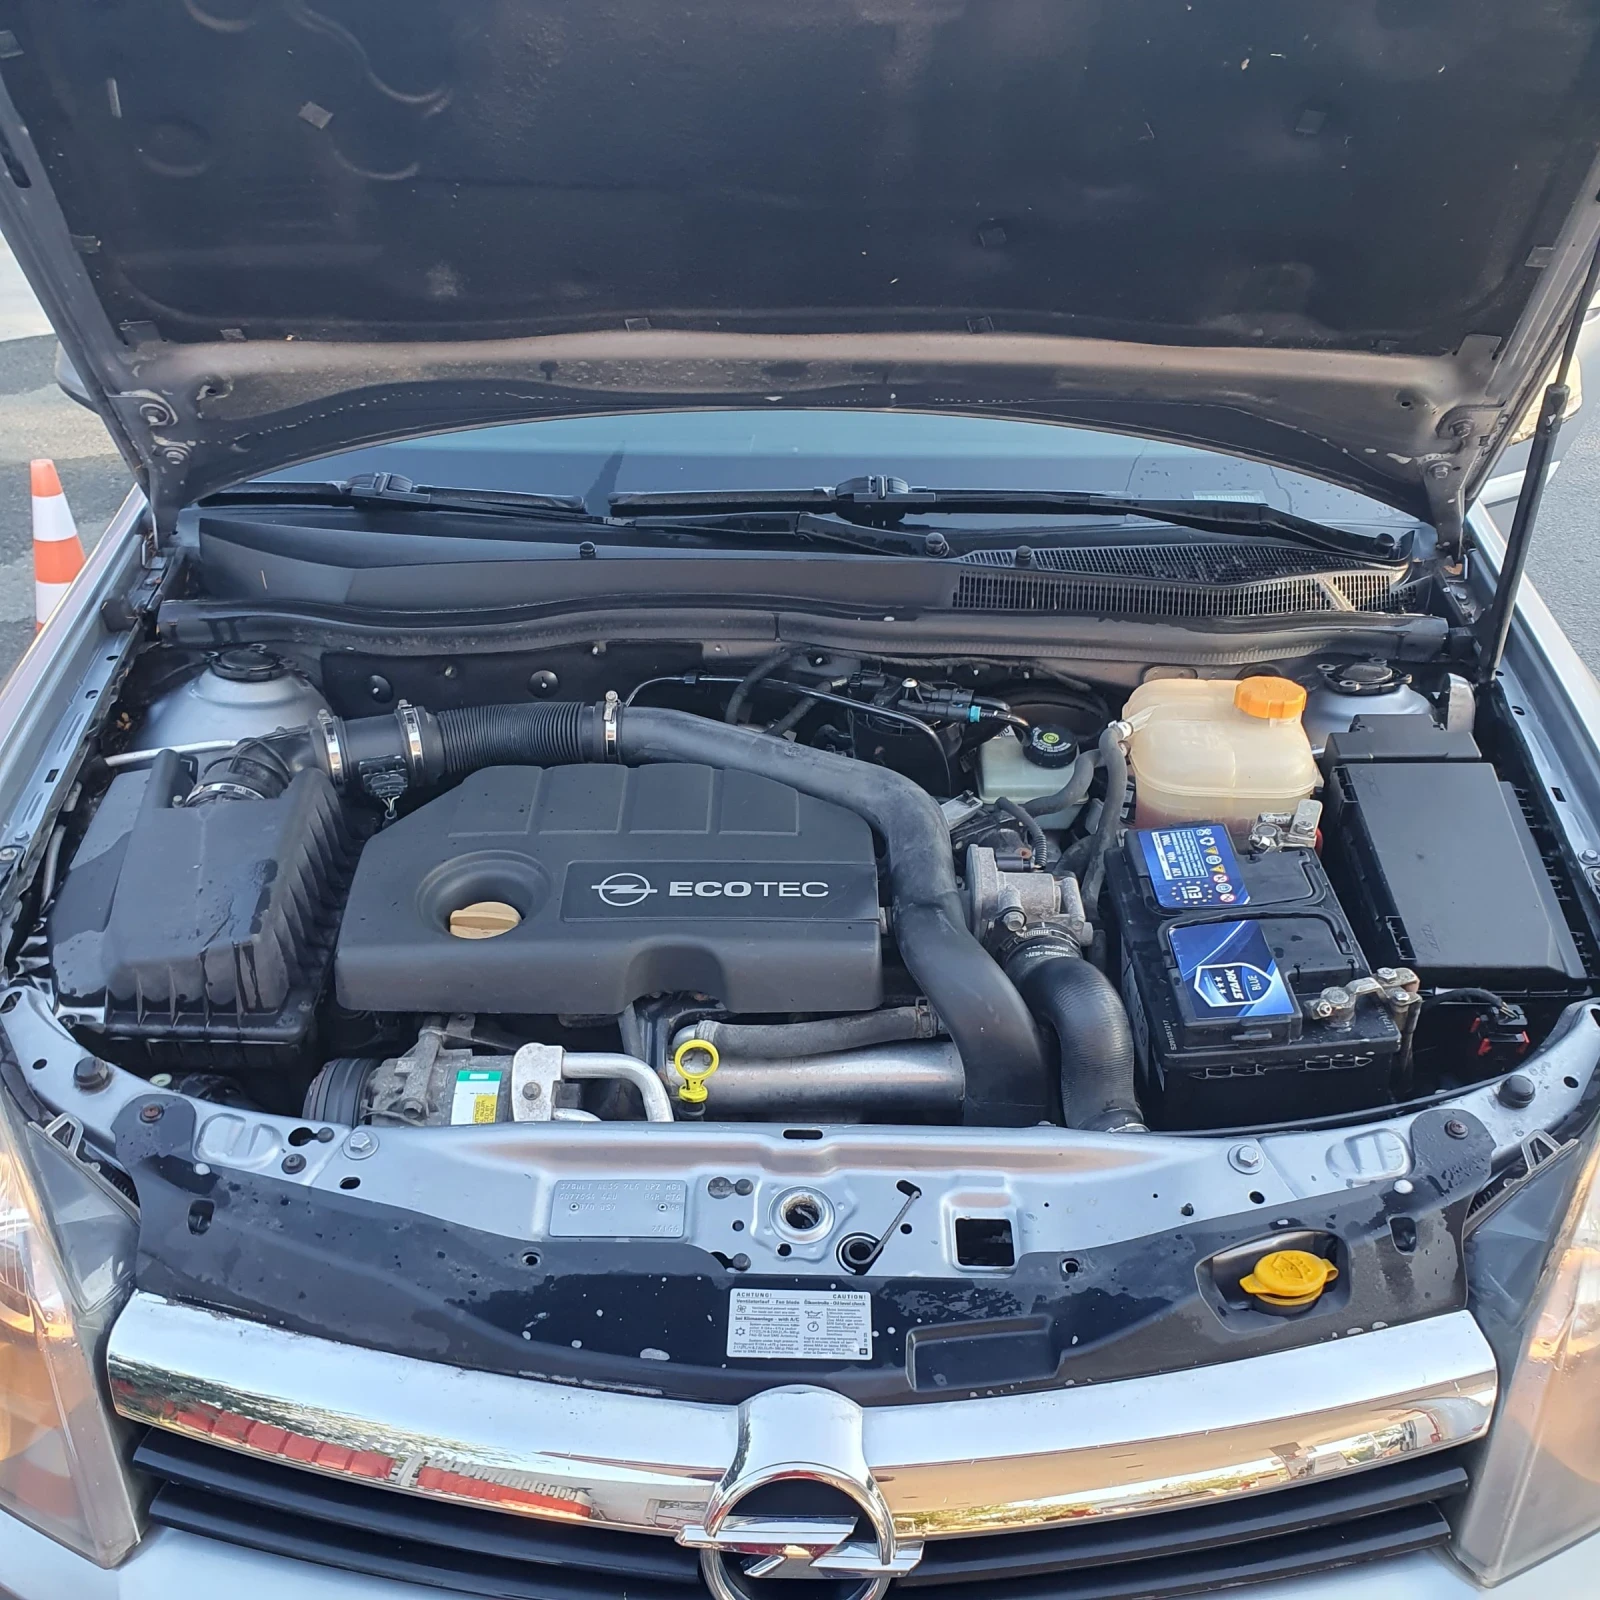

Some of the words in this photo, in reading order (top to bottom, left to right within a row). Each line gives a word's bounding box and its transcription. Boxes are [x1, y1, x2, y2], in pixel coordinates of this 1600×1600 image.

[1170, 867, 1182, 877] 12V
[668, 881, 830, 898] ECOTEC
[1186, 885, 1203, 899] EU
[1224, 968, 1245, 1000] STARK
[1247, 974, 1262, 991] BLUE
